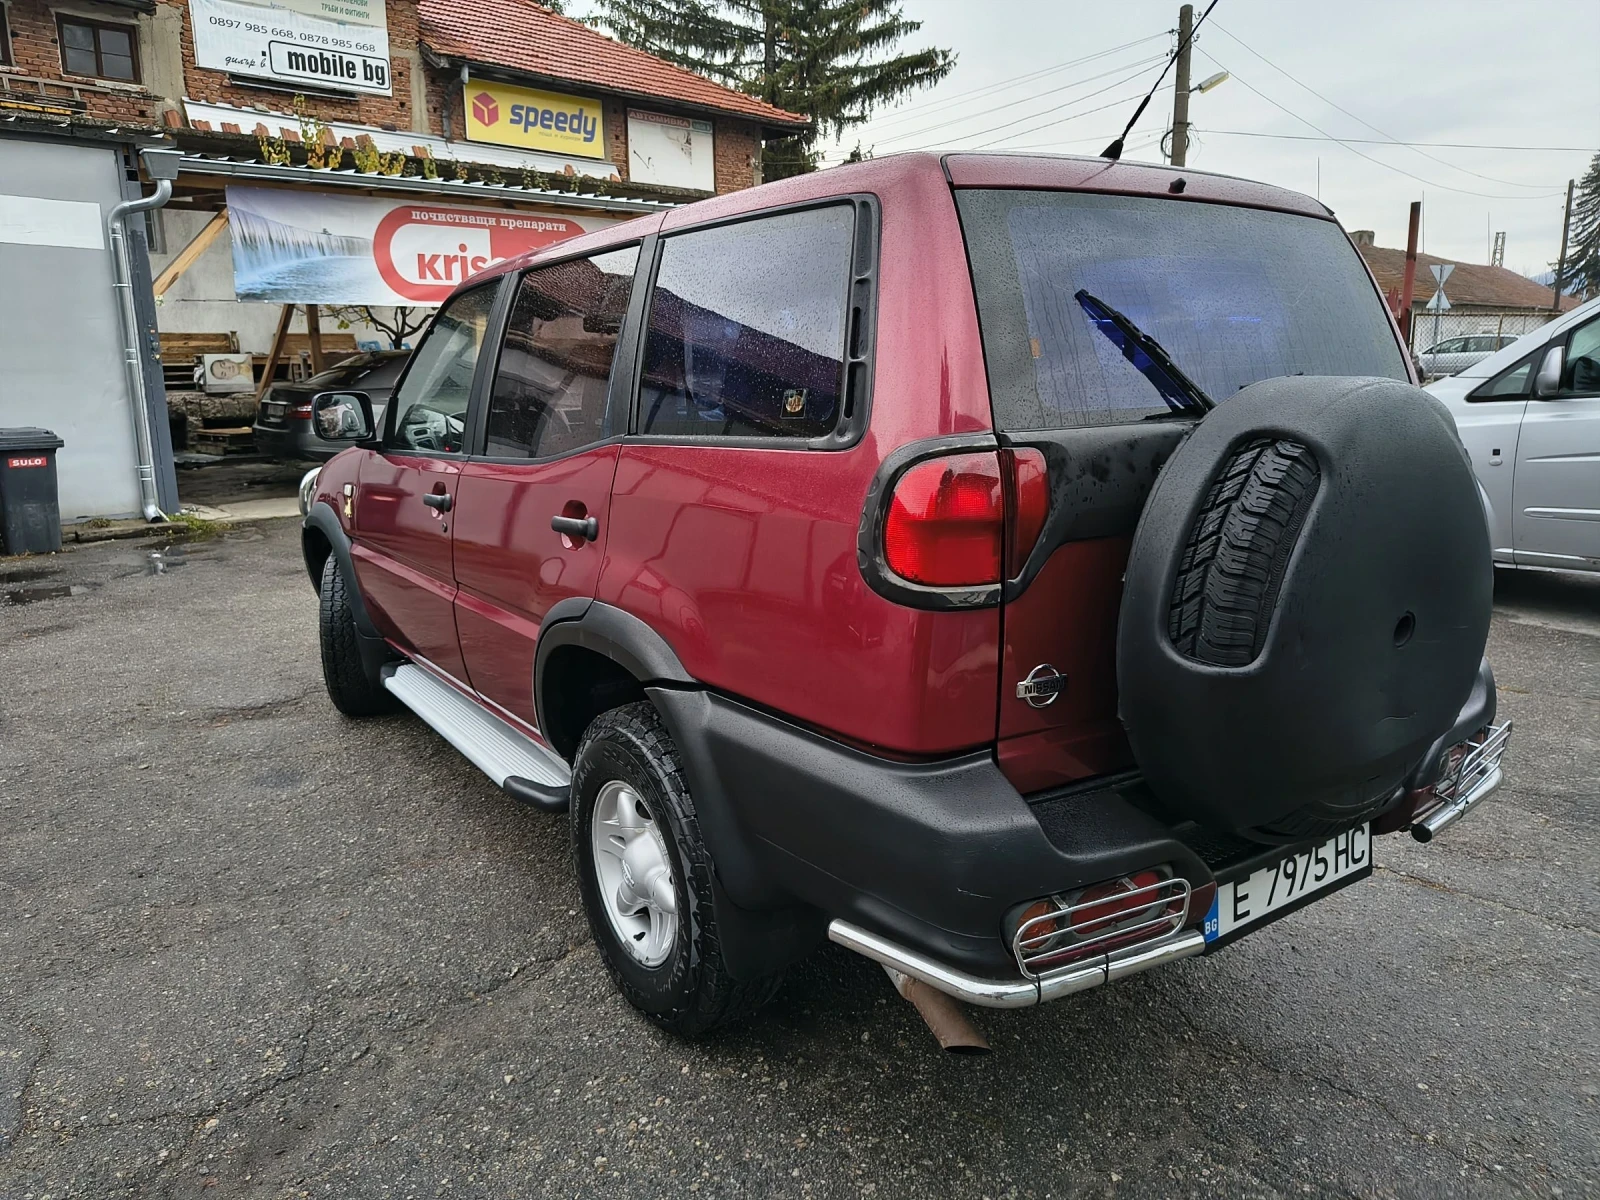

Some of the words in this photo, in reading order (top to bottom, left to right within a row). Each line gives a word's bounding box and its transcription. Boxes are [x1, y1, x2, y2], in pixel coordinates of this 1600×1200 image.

[320, 2, 339, 14] ТРЪБИ
[339, 6, 345, 15] И
[345, 8, 370, 20] ФИТИНГИ
[209, 16, 241, 29] 0897
[244, 22, 268, 35] 985
[271, 27, 297, 41] 668,
[299, 32, 329, 45] 0878
[331, 38, 352, 49] 985
[355, 42, 376, 53] 668
[225, 56, 256, 68] дилър
[287, 50, 357, 80] mobile
[363, 60, 386, 86] bg
[509, 104, 597, 142] speedy
[629, 111, 690, 128] АВТОМИВКА
[411, 210, 497, 226] почистващи
[499, 217, 567, 233] препарати
[12, 458, 43, 467] SULO
[1024, 679, 1065, 695] NISSAN
[1205, 918, 1218, 935] BG
